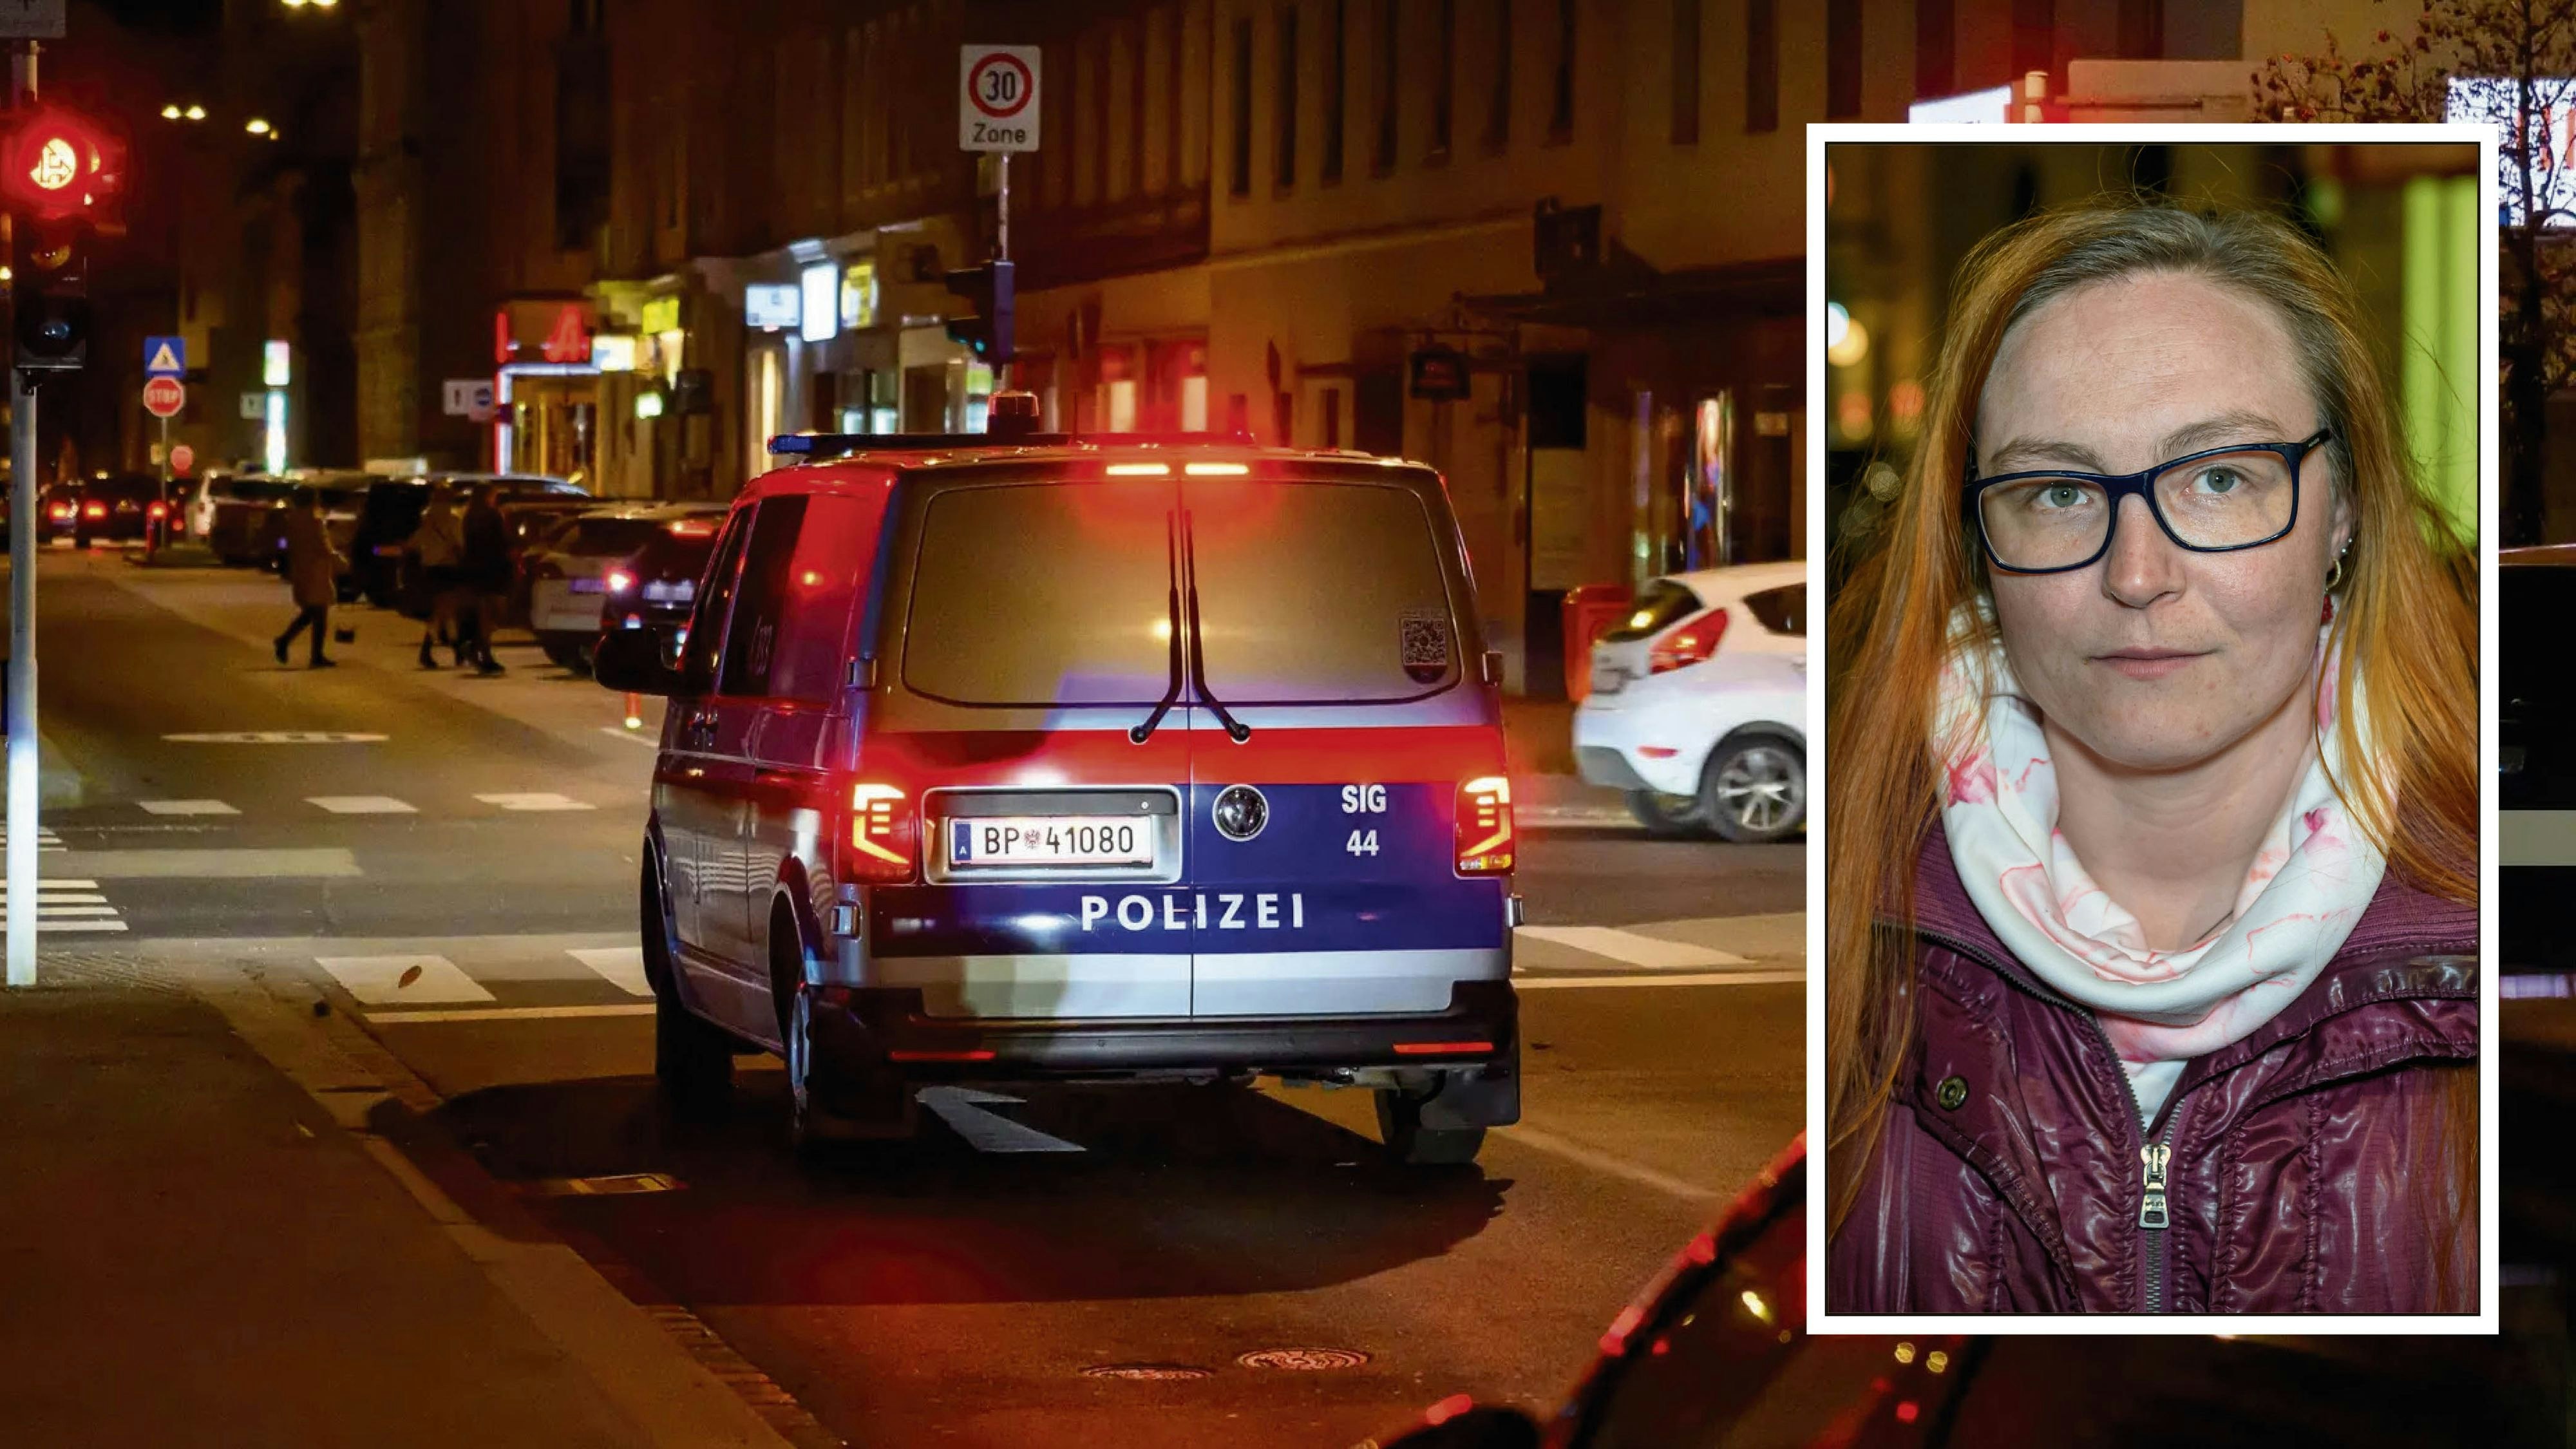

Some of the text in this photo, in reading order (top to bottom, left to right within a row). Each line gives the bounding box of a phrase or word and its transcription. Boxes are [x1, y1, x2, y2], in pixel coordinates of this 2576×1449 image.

[985, 70, 1015, 101] 30
[973, 122, 1026, 143] Zone
[1341, 785, 1387, 813] SIG
[959, 846, 967, 855] A
[985, 826, 1133, 854] BP 41080
[1347, 829, 1379, 857] 44
[1081, 893, 1304, 931] POLIZEI
